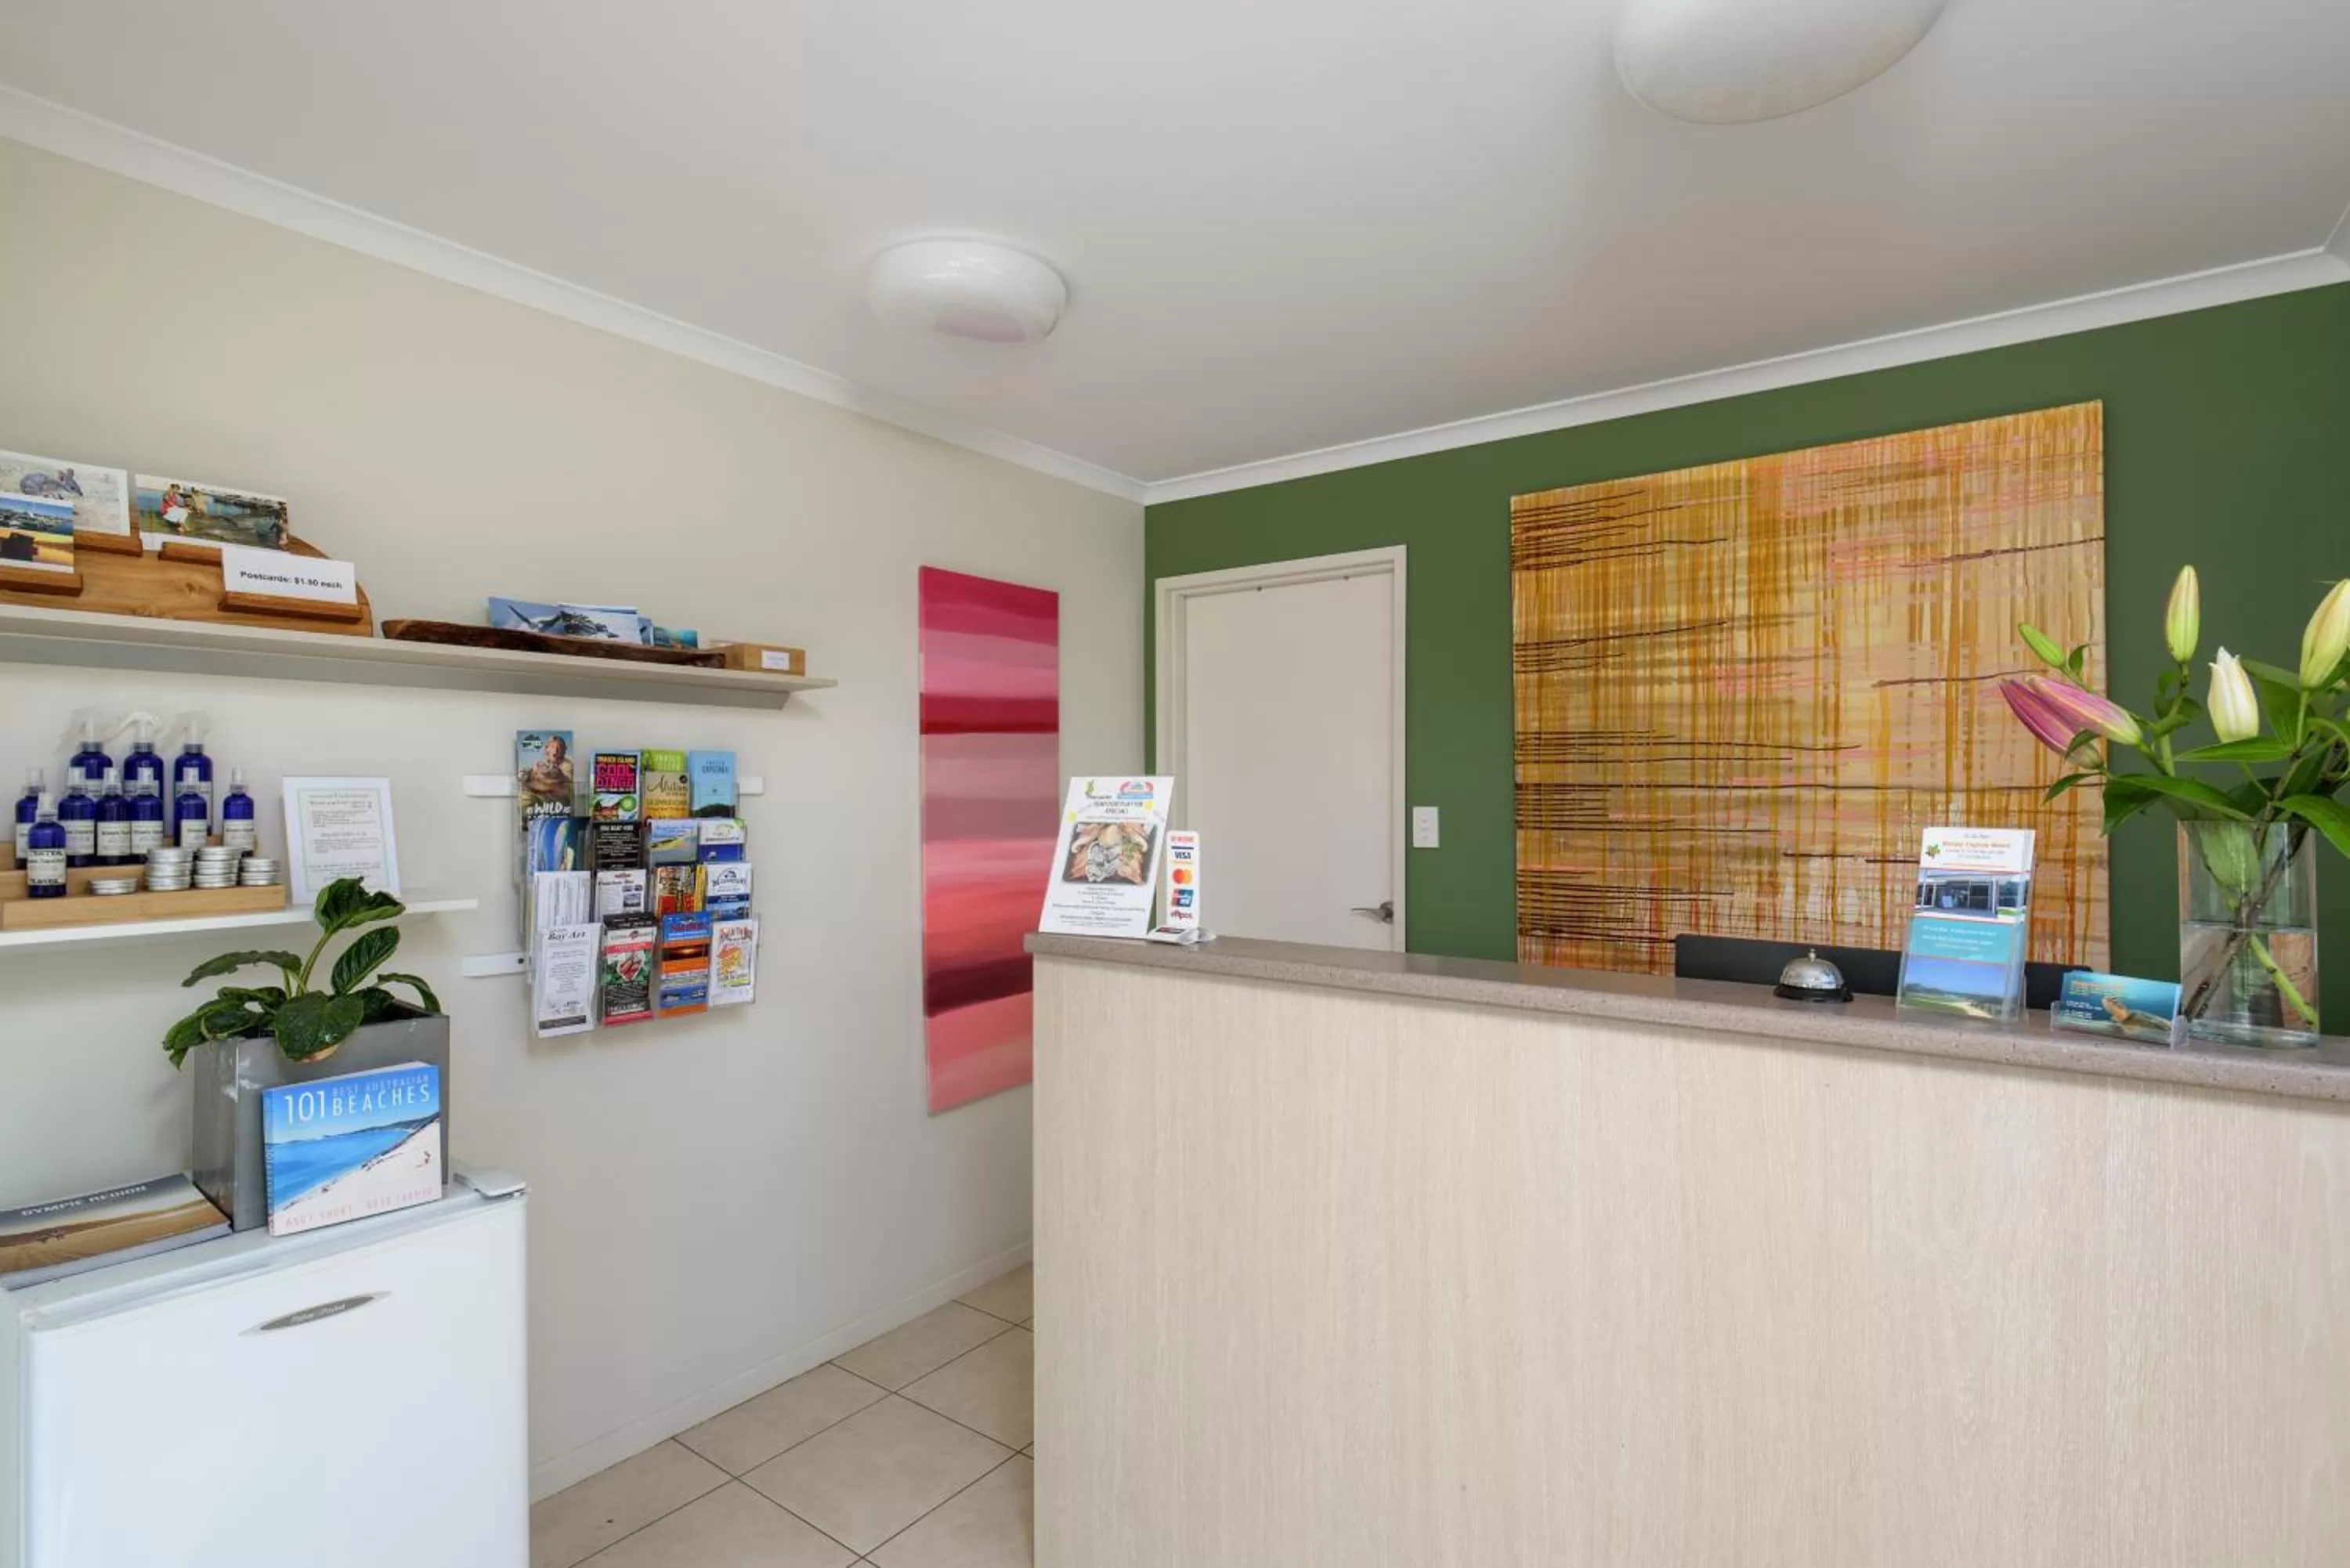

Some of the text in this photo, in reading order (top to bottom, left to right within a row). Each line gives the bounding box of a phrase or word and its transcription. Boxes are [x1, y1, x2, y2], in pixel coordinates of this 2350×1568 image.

[240, 570, 292, 584] Postcards:
[320, 581, 342, 590] each
[596, 764, 634, 776] COOL
[596, 776, 634, 789] DINGO
[534, 801, 563, 814] WILD
[1174, 851, 1191, 860] VISA
[284, 1083, 431, 1125] 101 BEACHES
[22, 1185, 147, 1216] GYMPIE REGION
